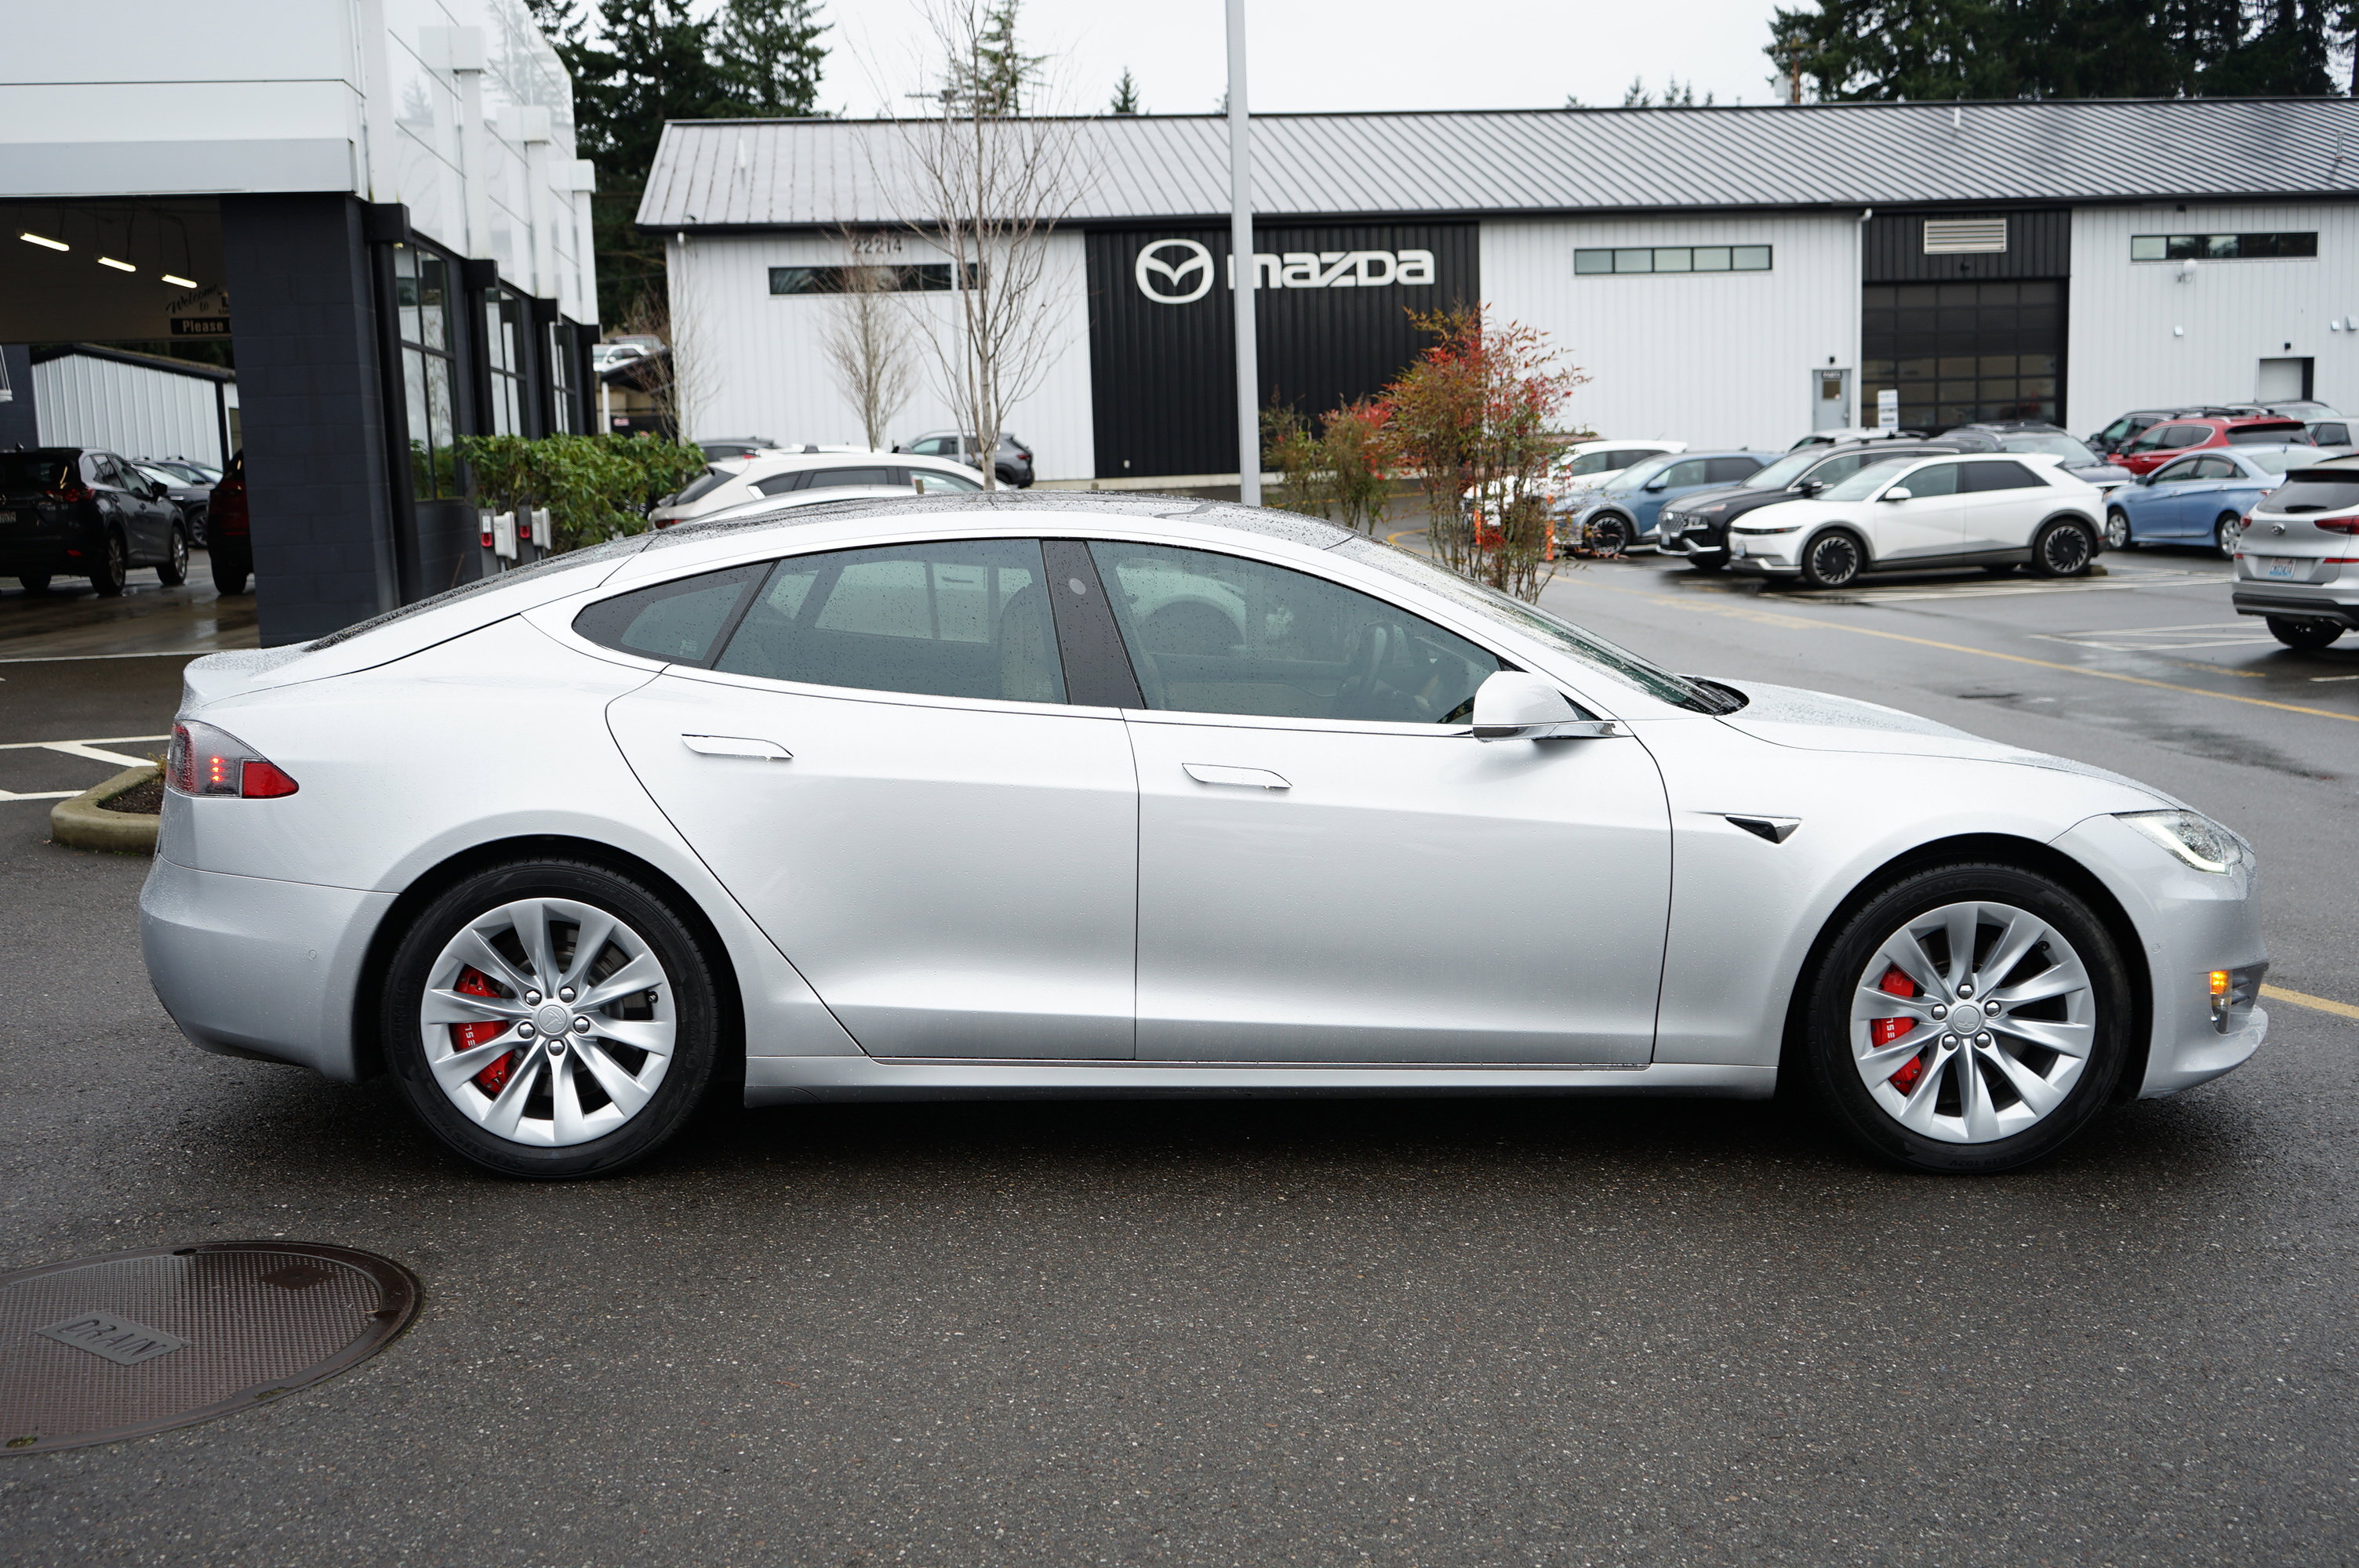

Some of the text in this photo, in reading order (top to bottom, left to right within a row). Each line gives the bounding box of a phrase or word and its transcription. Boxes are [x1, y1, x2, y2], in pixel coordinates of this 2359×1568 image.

[854, 238, 903, 255] 22214
[165, 283, 220, 314] Welcome
[199, 301, 209, 313] to
[182, 319, 224, 333] Please
[56, 1318, 168, 1357] DRAIN
